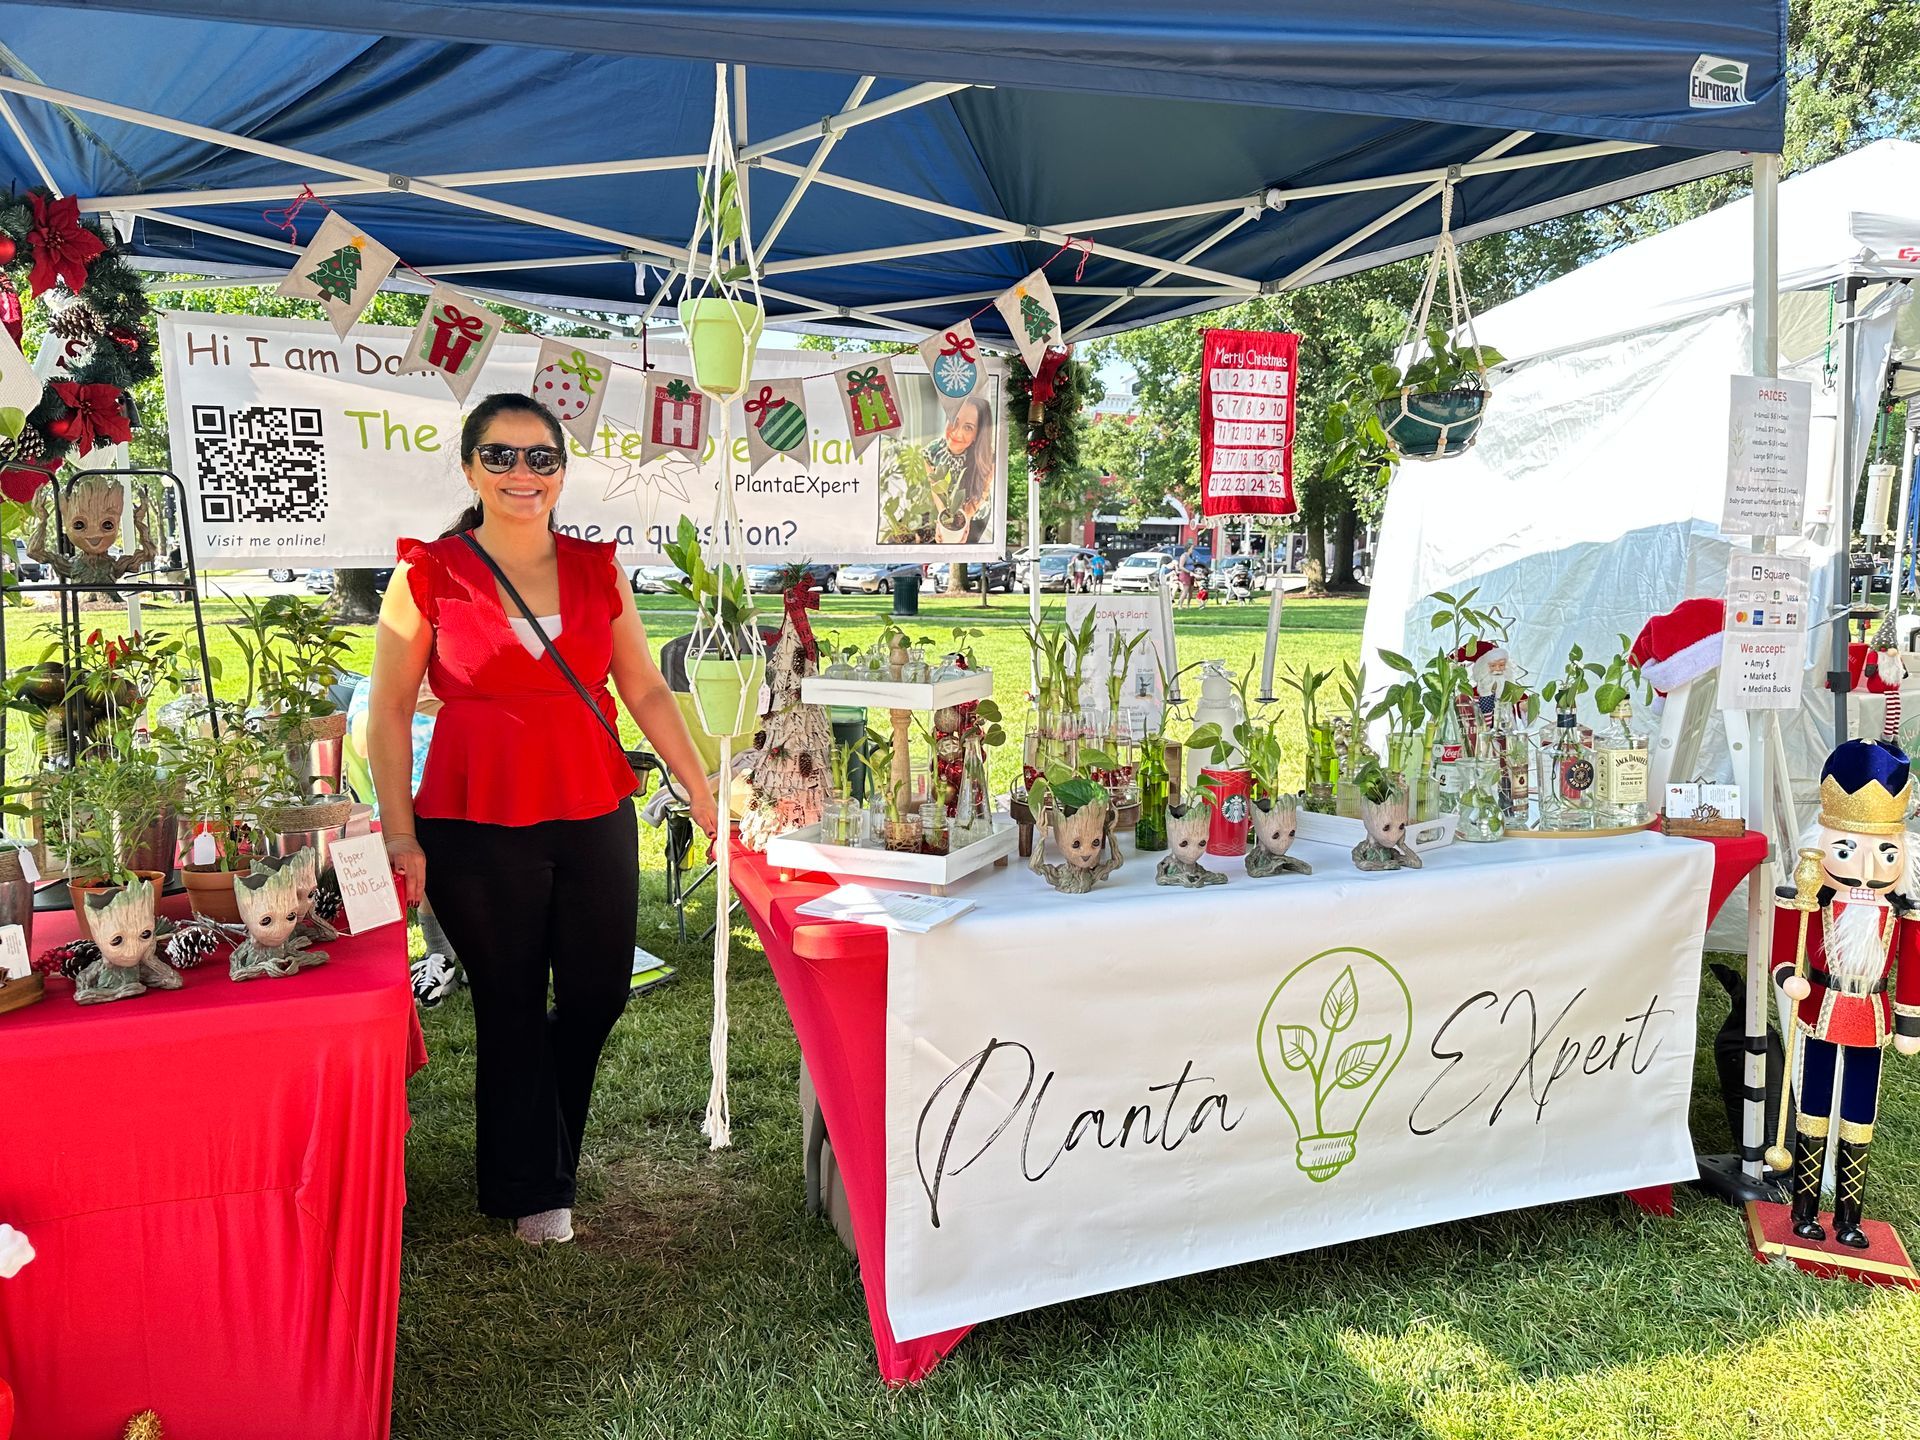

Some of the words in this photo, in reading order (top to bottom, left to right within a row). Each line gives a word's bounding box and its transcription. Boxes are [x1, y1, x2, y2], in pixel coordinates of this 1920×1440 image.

[1692, 76, 1741, 102] Eurmax
[187, 332, 231, 366] Hi
[246, 336, 270, 368] I
[284, 348, 339, 373] am
[1214, 346, 1244, 368] Merry
[1246, 350, 1288, 368] Christmas
[1215, 373, 1220, 387] 1
[1232, 373, 1239, 387] 2
[1249, 373, 1255, 388] 3
[1261, 374, 1267, 386] 4
[1275, 375, 1281, 389] 5
[1758, 390, 1787, 402] PRICES
[1216, 400, 1224, 413] 6
[1232, 400, 1239, 414] 7
[1246, 401, 1251, 415] 8
[1259, 403, 1265, 415] 9
[1273, 403, 1283, 416] 10
[344, 410, 442, 452] The
[1219, 425, 1226, 439] 11
[1232, 426, 1240, 440] 12
[1244, 427, 1252, 440] 13
[1257, 427, 1267, 440] 14
[1272, 428, 1283, 442] 15
[1215, 452, 1223, 465] 16
[1226, 452, 1236, 465] 17
[1240, 453, 1248, 466] 18
[1254, 453, 1264, 466] 19
[1268, 455, 1281, 468] 20
[1210, 478, 1219, 491] 21
[1220, 478, 1232, 491] 22
[1235, 478, 1246, 491] 23
[1251, 478, 1265, 492] 24
[1268, 480, 1281, 493] 25
[207, 534, 242, 547] Visit
[250, 537, 271, 546] me
[277, 534, 326, 547] online!
[616, 525, 634, 545] a
[1764, 569, 1790, 582] Square
[1096, 610, 1125, 619] ODAY's
[1126, 610, 1148, 619] Plant
[1740, 643, 1754, 653] We
[1755, 644, 1786, 656] accept:
[1750, 660, 1764, 669] Amy
[1766, 659, 1770, 668] $
[1749, 672, 1771, 680] Market
[1772, 672, 1777, 681] $
[1773, 685, 1791, 693] Bucks
[1572, 763, 1592, 772] BLADE
[1616, 757, 1629, 767] JACK
[338, 852, 364, 867] Pepper
[343, 867, 366, 880] Plants
[368, 876, 390, 892] Each
[914, 1036, 1247, 1229] Planta
[1408, 987, 1675, 1135] EXpert
